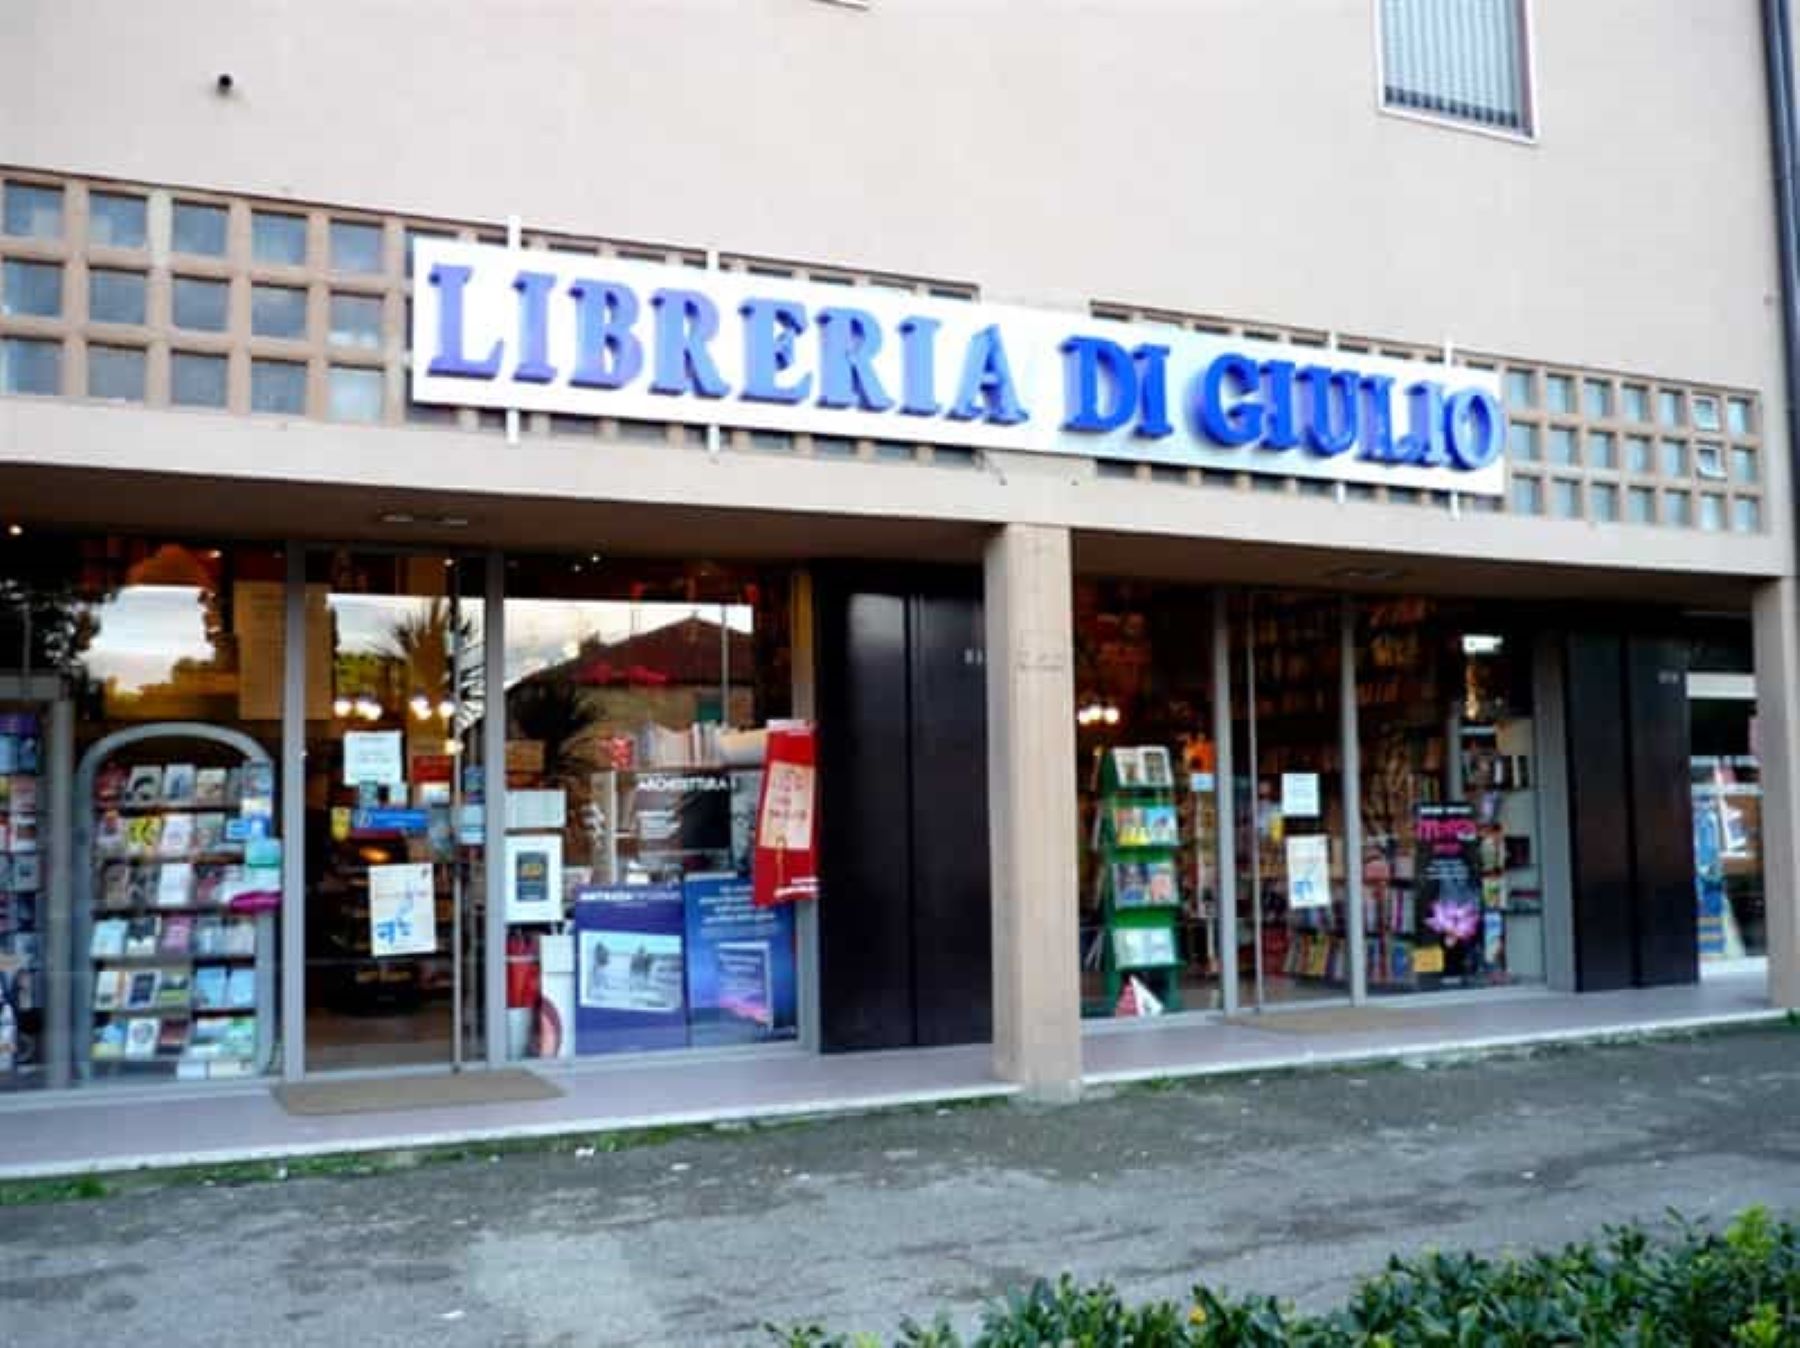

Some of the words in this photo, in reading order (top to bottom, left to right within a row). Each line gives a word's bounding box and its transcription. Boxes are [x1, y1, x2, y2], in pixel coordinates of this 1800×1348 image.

[427, 262, 1028, 425] LIBRERIA
[1059, 335, 1174, 440] DI
[1192, 352, 1505, 472] GIULIO
